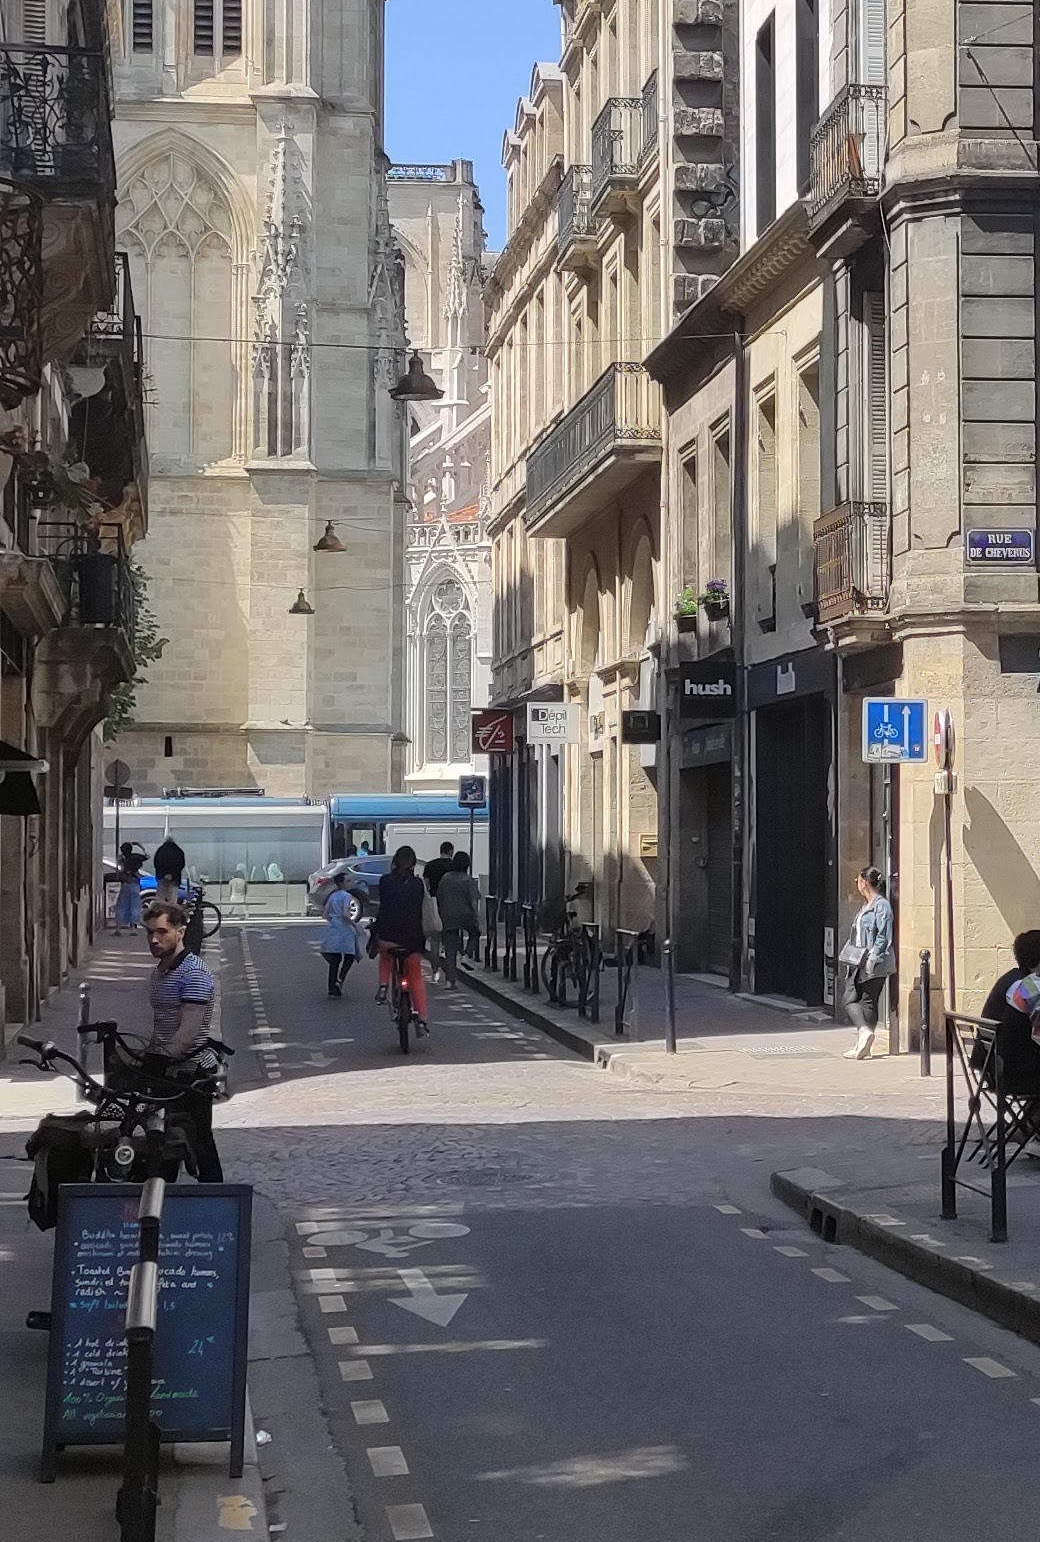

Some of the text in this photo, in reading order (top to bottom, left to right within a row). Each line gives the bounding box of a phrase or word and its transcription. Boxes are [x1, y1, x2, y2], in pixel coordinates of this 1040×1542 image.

[988, 533, 1012, 544] RUE
[970, 547, 1031, 559] DE CHEVERUS
[684, 678, 732, 696] hush
[539, 723, 566, 734] Tech
[77, 1264, 110, 1275] Toasted
[85, 1337, 100, 1347] hot
[84, 1349, 100, 1358] cold
